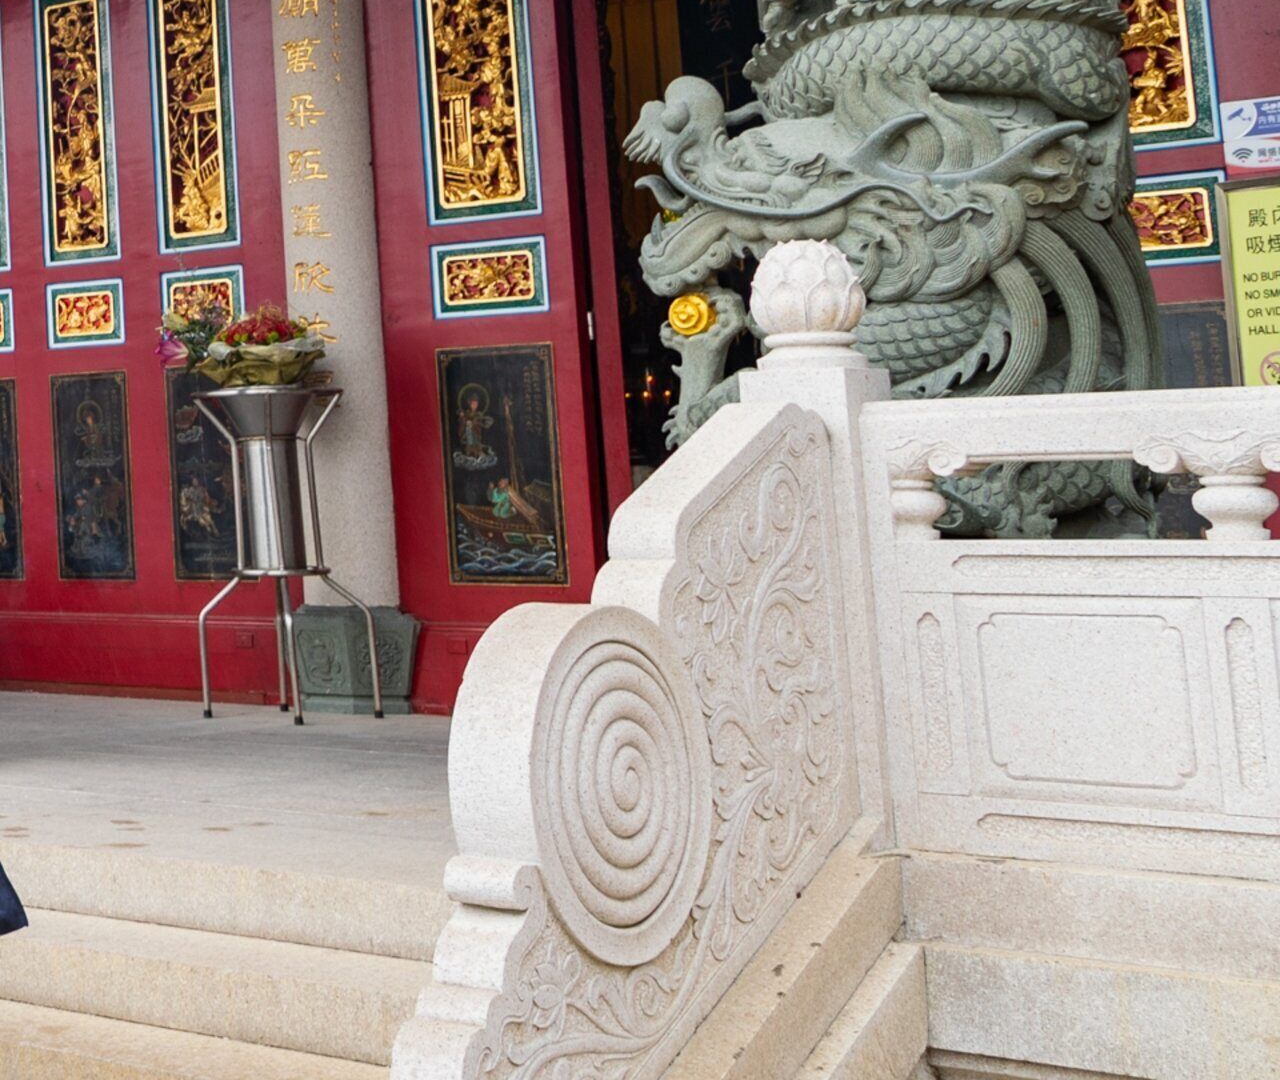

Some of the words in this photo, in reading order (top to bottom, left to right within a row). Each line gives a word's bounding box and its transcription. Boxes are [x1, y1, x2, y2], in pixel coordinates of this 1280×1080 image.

[1243, 272, 1259, 283] NO
[1245, 290, 1261, 300] NO
[1247, 308, 1263, 318] OR
